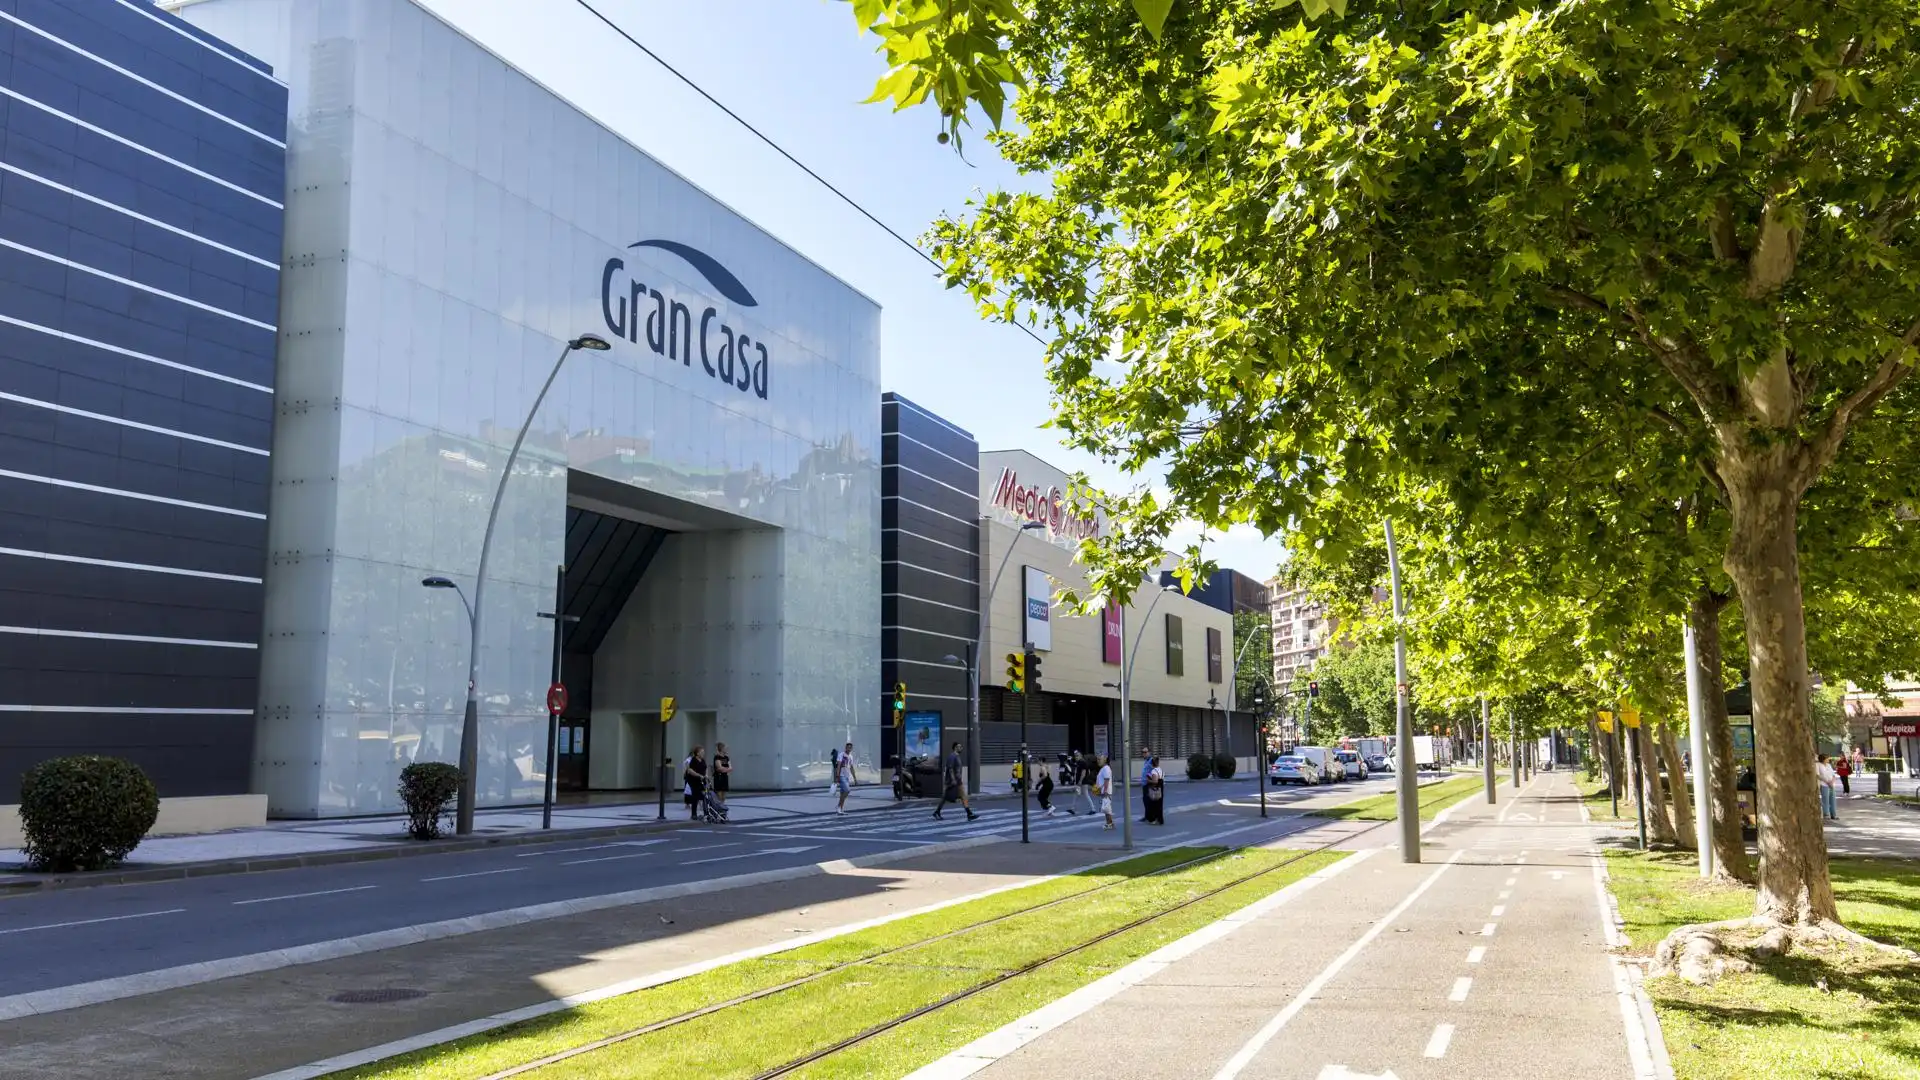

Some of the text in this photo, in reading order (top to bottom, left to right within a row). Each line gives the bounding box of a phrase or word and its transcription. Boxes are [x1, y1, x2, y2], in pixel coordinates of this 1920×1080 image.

[601, 257, 768, 401] Gran Casa
[991, 466, 1047, 525] Media
[1029, 602, 1047, 617] pepco
[1883, 724, 1916, 736] telepizza
